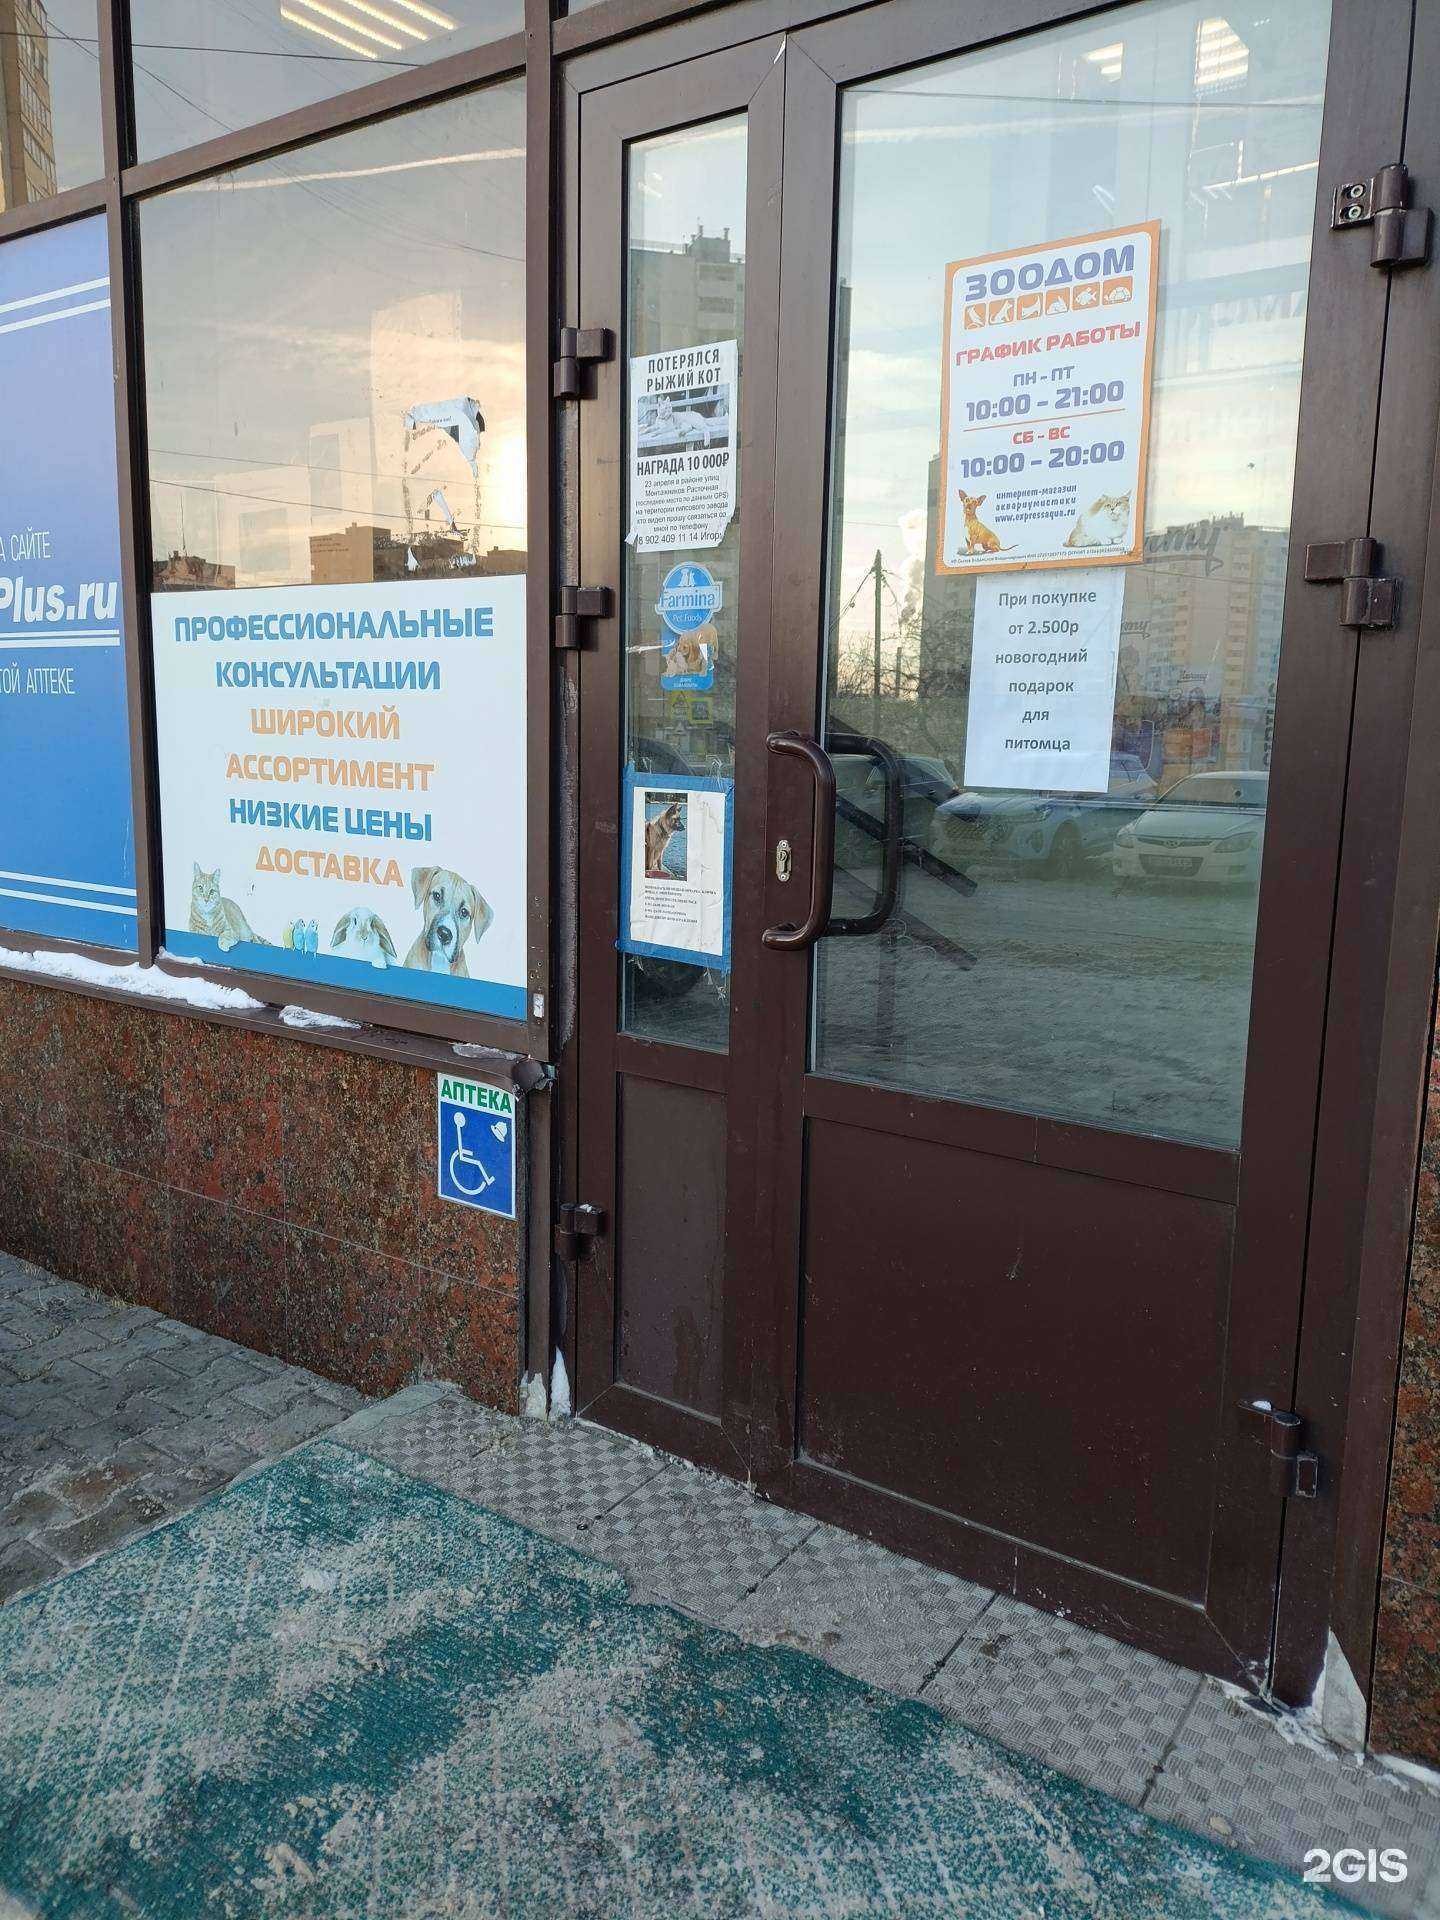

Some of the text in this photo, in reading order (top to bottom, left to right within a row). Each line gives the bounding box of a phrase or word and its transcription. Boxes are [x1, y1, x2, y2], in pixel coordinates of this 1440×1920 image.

[965, 244, 1134, 302] ЗООДОМ
[956, 322, 1140, 366] ГРАФИК РАБОТЫ
[648, 349, 719, 373] ПОТЕРЯЛСЯ
[647, 368, 720, 392] РЫЖИЙ КОТ
[1014, 372, 1036, 387] ПН
[1052, 366, 1074, 381] ПТ
[966, 394, 1030, 421] 10:00
[1055, 380, 1124, 409] 21:00
[1012, 431, 1034, 444] СБ
[1048, 426, 1070, 440] ВС
[637, 458, 684, 476] НАГРАДА
[961, 453, 1024, 478] 10:00
[1048, 440, 1124, 468] 20:00
[996, 485, 1076, 500] интернет-магазин
[996, 498, 1076, 511] аквариумистики
[995, 509, 1076, 522] www.expressaqua.ru
[10, 526, 50, 561] САЙТЕ
[646, 535, 659, 544] 902
[661, 534, 676, 543] 409
[998, 592, 1097, 609] При покупке
[175, 607, 494, 641] ПРОФЕССИОНАЛЬНЫЕ
[1009, 620, 1079, 636] от 2.500р
[996, 648, 1088, 665] новогодний
[26, 668, 75, 694] АПТЕКЕ
[216, 661, 440, 690] КОНСУЛЬТАЦИИ
[1009, 680, 1074, 694] подарок
[251, 704, 400, 739] ШИРОКИЙ
[1022, 710, 1050, 724] для
[1005, 738, 1071, 753] питомца
[226, 754, 434, 791] АССОРТИМЕНТ
[230, 798, 432, 841] НИЗКИЕ ЦЕНЫ
[256, 846, 404, 887] ДОСТАВКА
[441, 1080, 512, 1113] АПТЕКА
